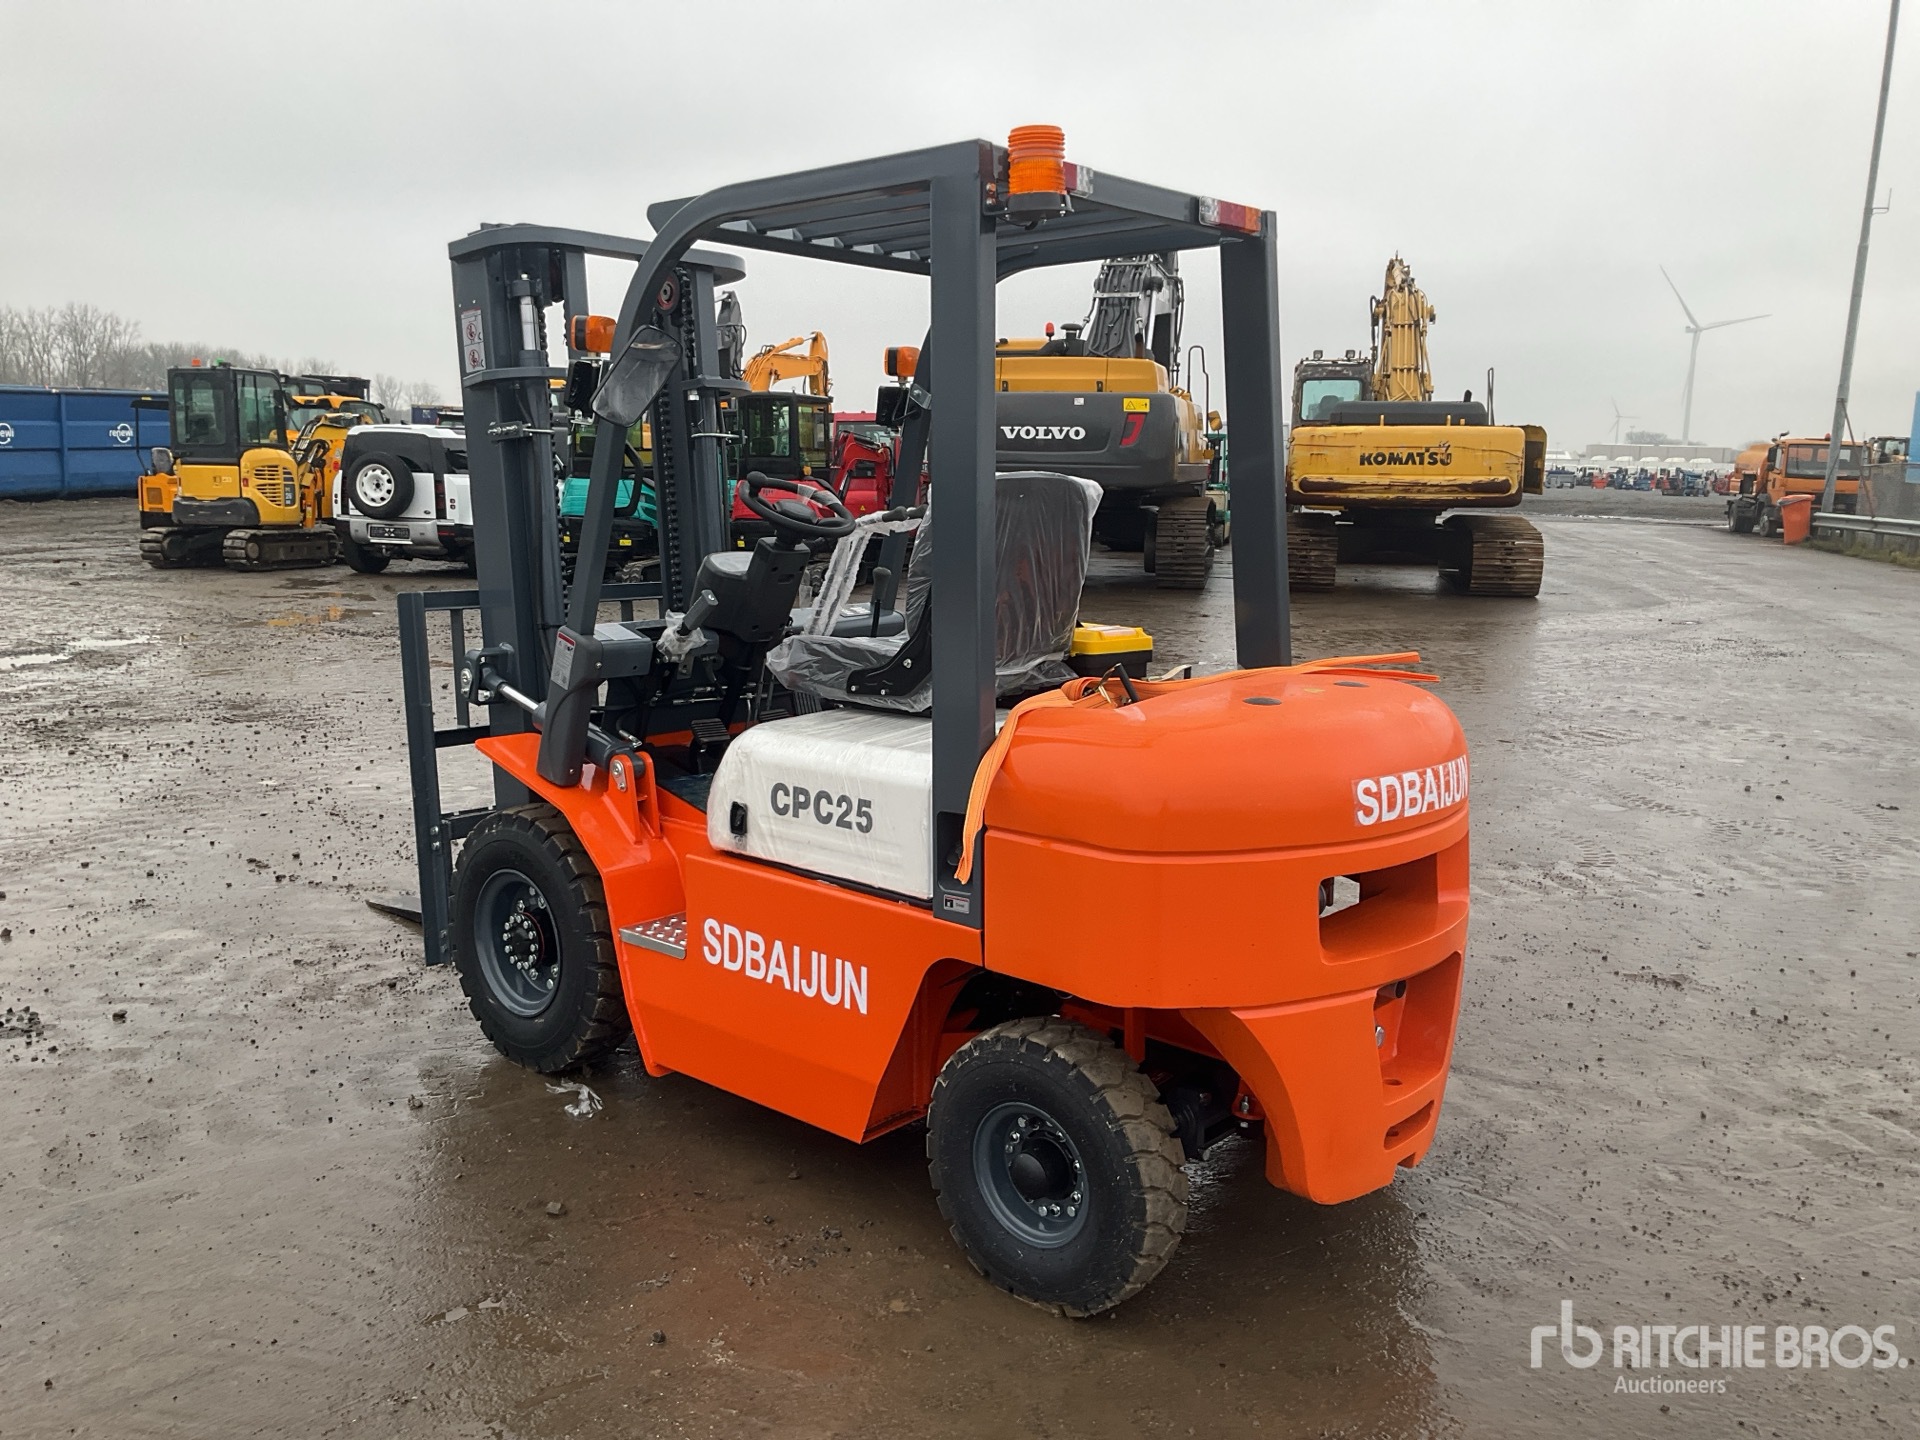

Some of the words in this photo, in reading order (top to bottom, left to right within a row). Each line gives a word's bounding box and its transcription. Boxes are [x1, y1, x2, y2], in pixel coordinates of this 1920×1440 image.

[109, 428, 133, 437] renewi
[1000, 426, 1086, 440] VOLVO
[1359, 451, 1452, 466] KOMATSU
[1356, 754, 1469, 826] SDBAIJUN
[770, 782, 873, 834] CPC25
[703, 918, 868, 1015] SDBAIJUN
